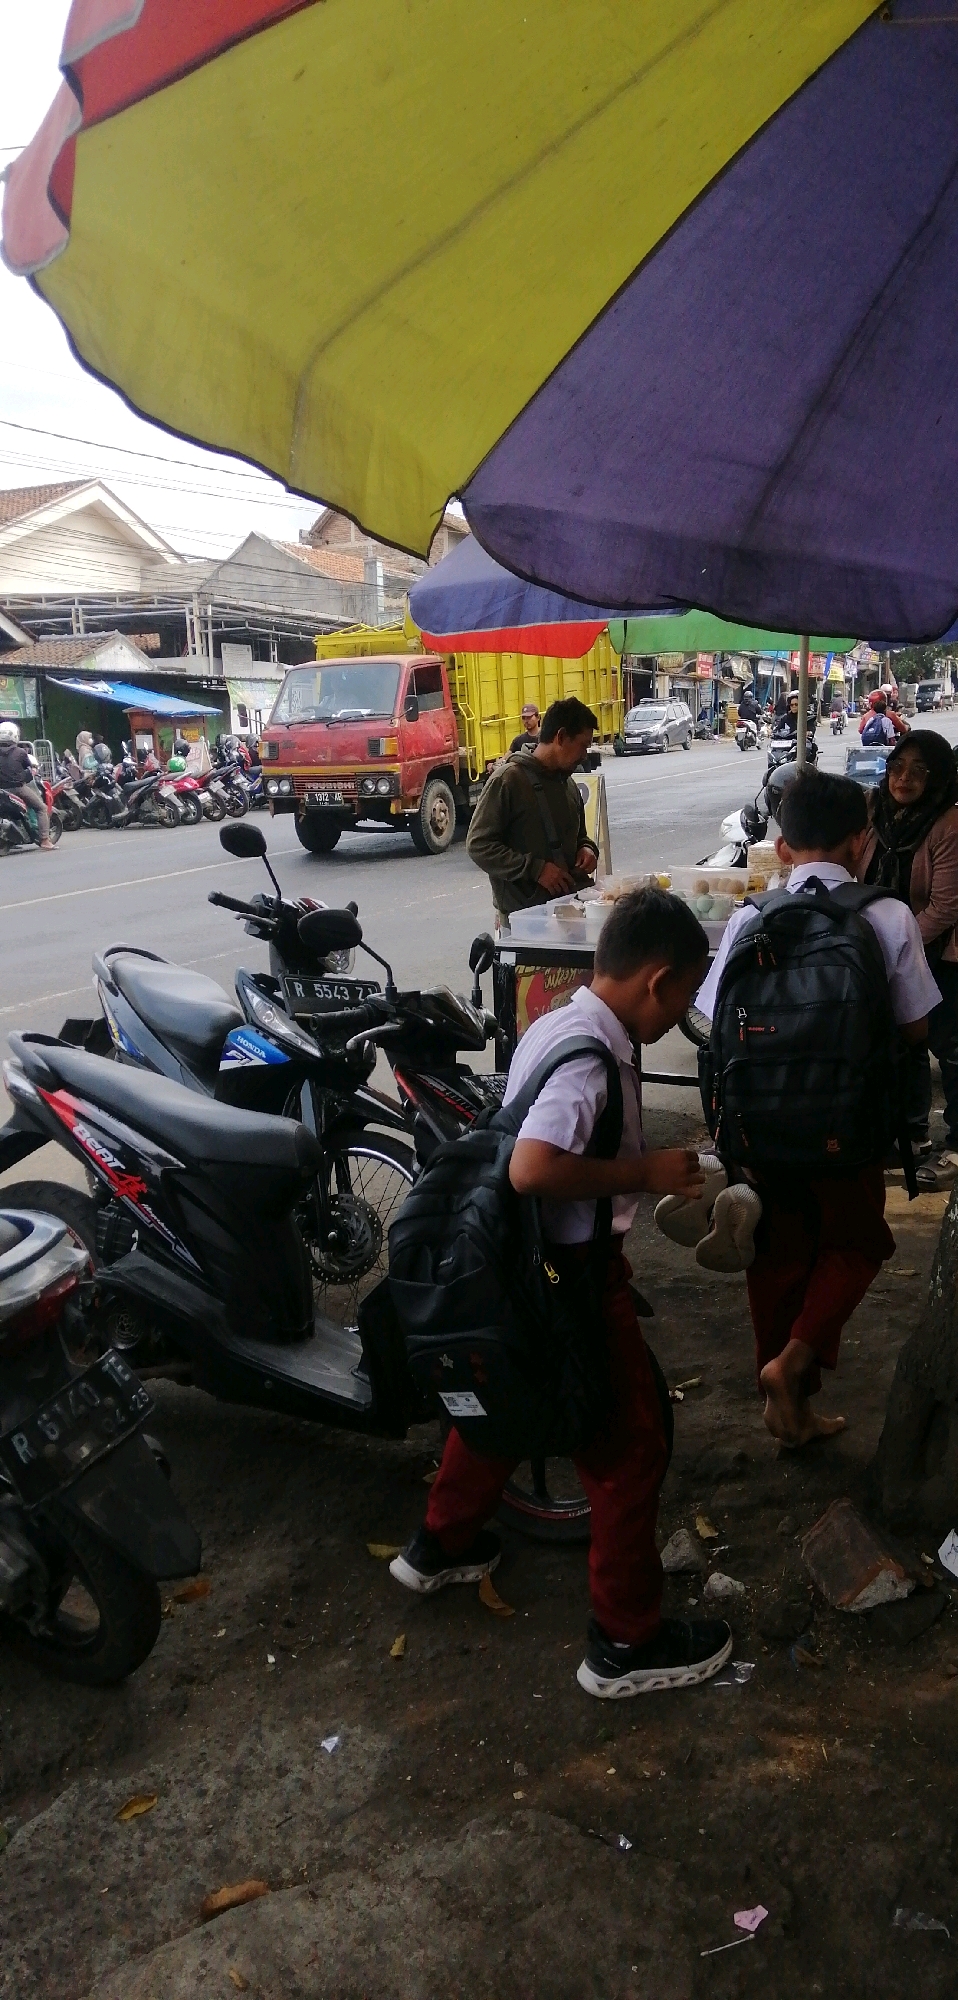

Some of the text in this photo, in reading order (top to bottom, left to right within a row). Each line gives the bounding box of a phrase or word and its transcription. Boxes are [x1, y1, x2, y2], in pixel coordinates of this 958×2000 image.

[294, 982, 305, 997] R
[314, 984, 350, 1000] 5543
[237, 1035, 266, 1058] HONDA
[11, 1432, 37, 1464] R
